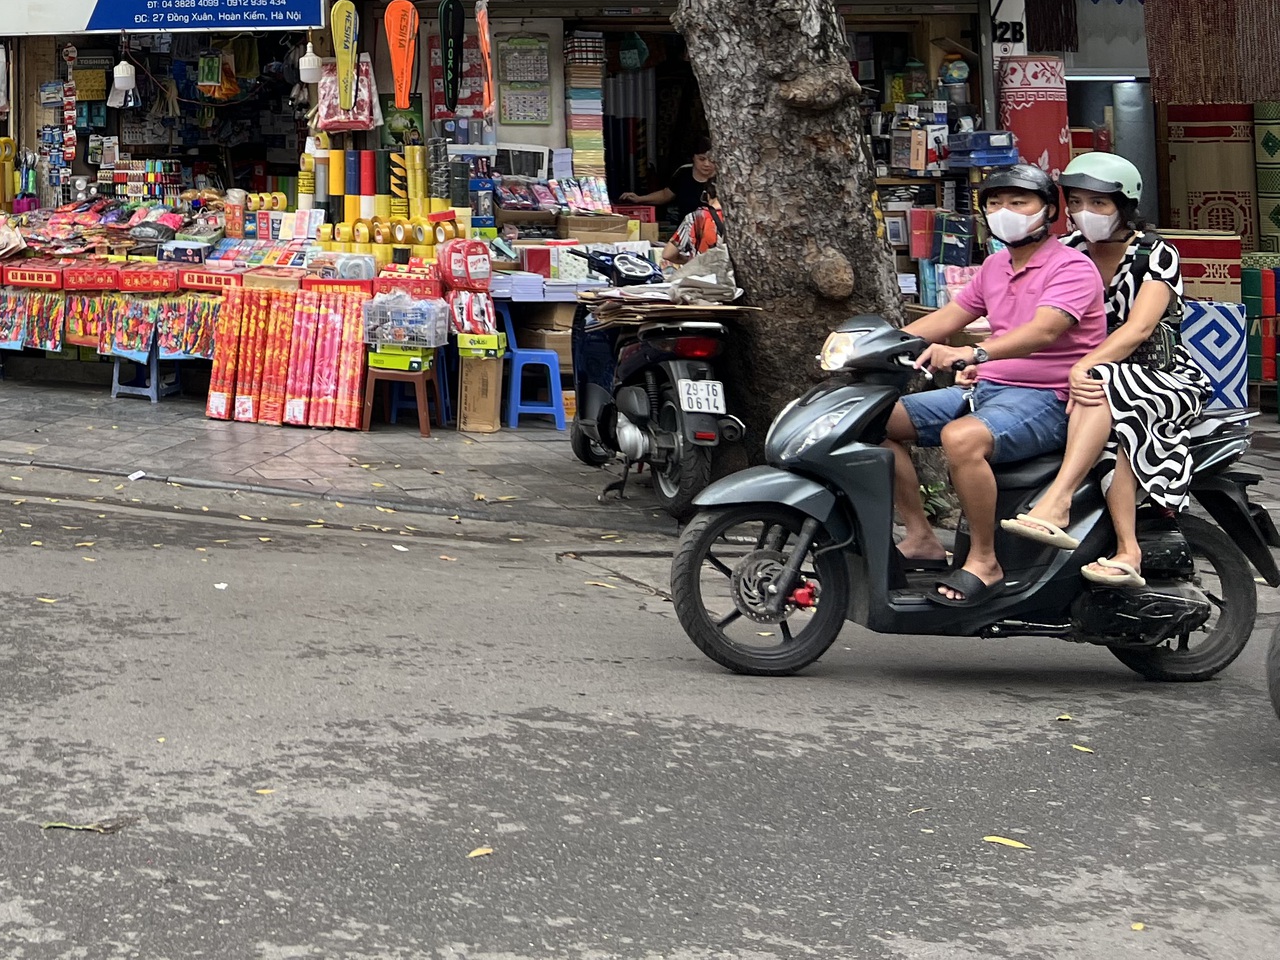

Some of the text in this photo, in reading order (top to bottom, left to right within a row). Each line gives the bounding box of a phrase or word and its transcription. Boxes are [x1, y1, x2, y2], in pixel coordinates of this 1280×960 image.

[147, 0, 160, 9] ĐT:
[161, 0, 173, 8] 04
[198, 0, 219, 7] 4099
[134, 15, 150, 23] ĐC:
[152, 14, 164, 22] 27
[167, 12, 190, 23] Đồng
[218, 11, 241, 21] Hoàn
[270, 11, 284, 20] Hà
[286, 11, 302, 21] Nội
[79, 58, 110, 66] TOSHIBA
[685, 382, 718, 397] 29-T6
[687, 396, 719, 411] 0614
